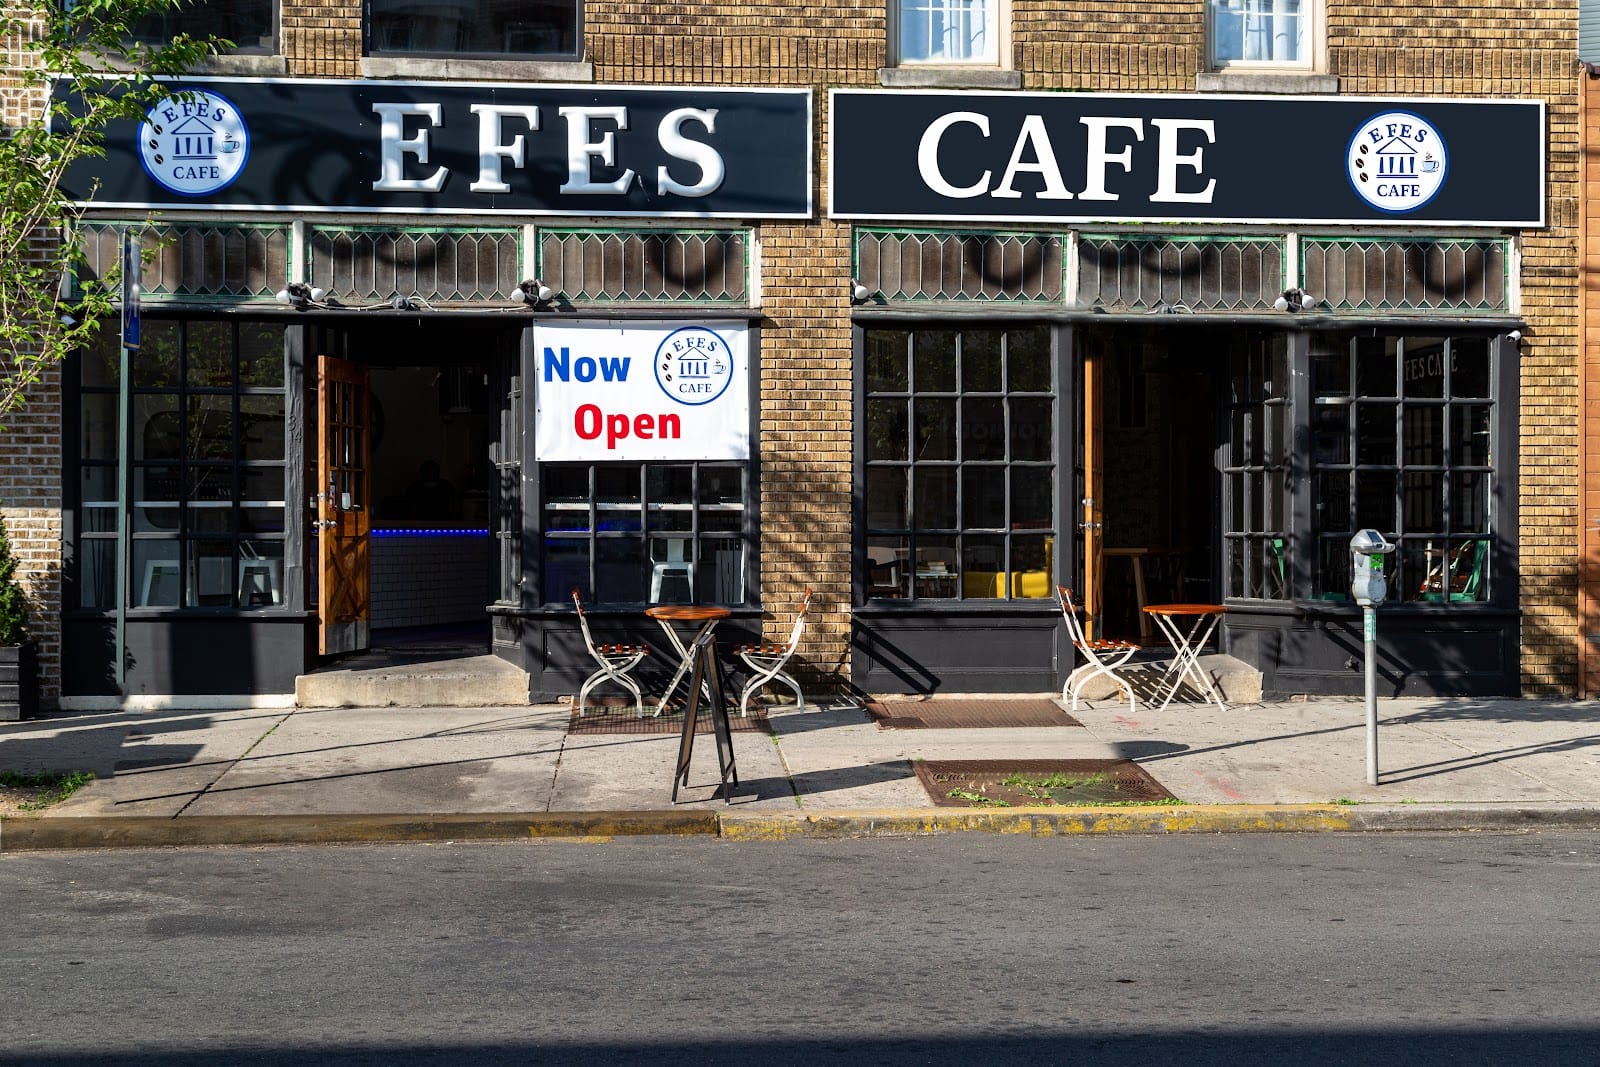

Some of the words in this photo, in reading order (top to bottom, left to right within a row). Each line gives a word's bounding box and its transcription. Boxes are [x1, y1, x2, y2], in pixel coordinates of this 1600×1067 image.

[162, 102, 226, 124] EFES
[1368, 123, 1427, 144] EFES
[372, 102, 726, 198] EFES
[917, 111, 1217, 204] CAFE
[173, 166, 220, 179] CAFE
[1376, 184, 1421, 197] CAFE
[672, 337, 717, 352] EFES
[543, 347, 631, 382] Now
[1399, 357, 1425, 381] FES
[1427, 349, 1458, 376] CAE
[679, 383, 712, 393] CAFE
[574, 403, 681, 449] Open
